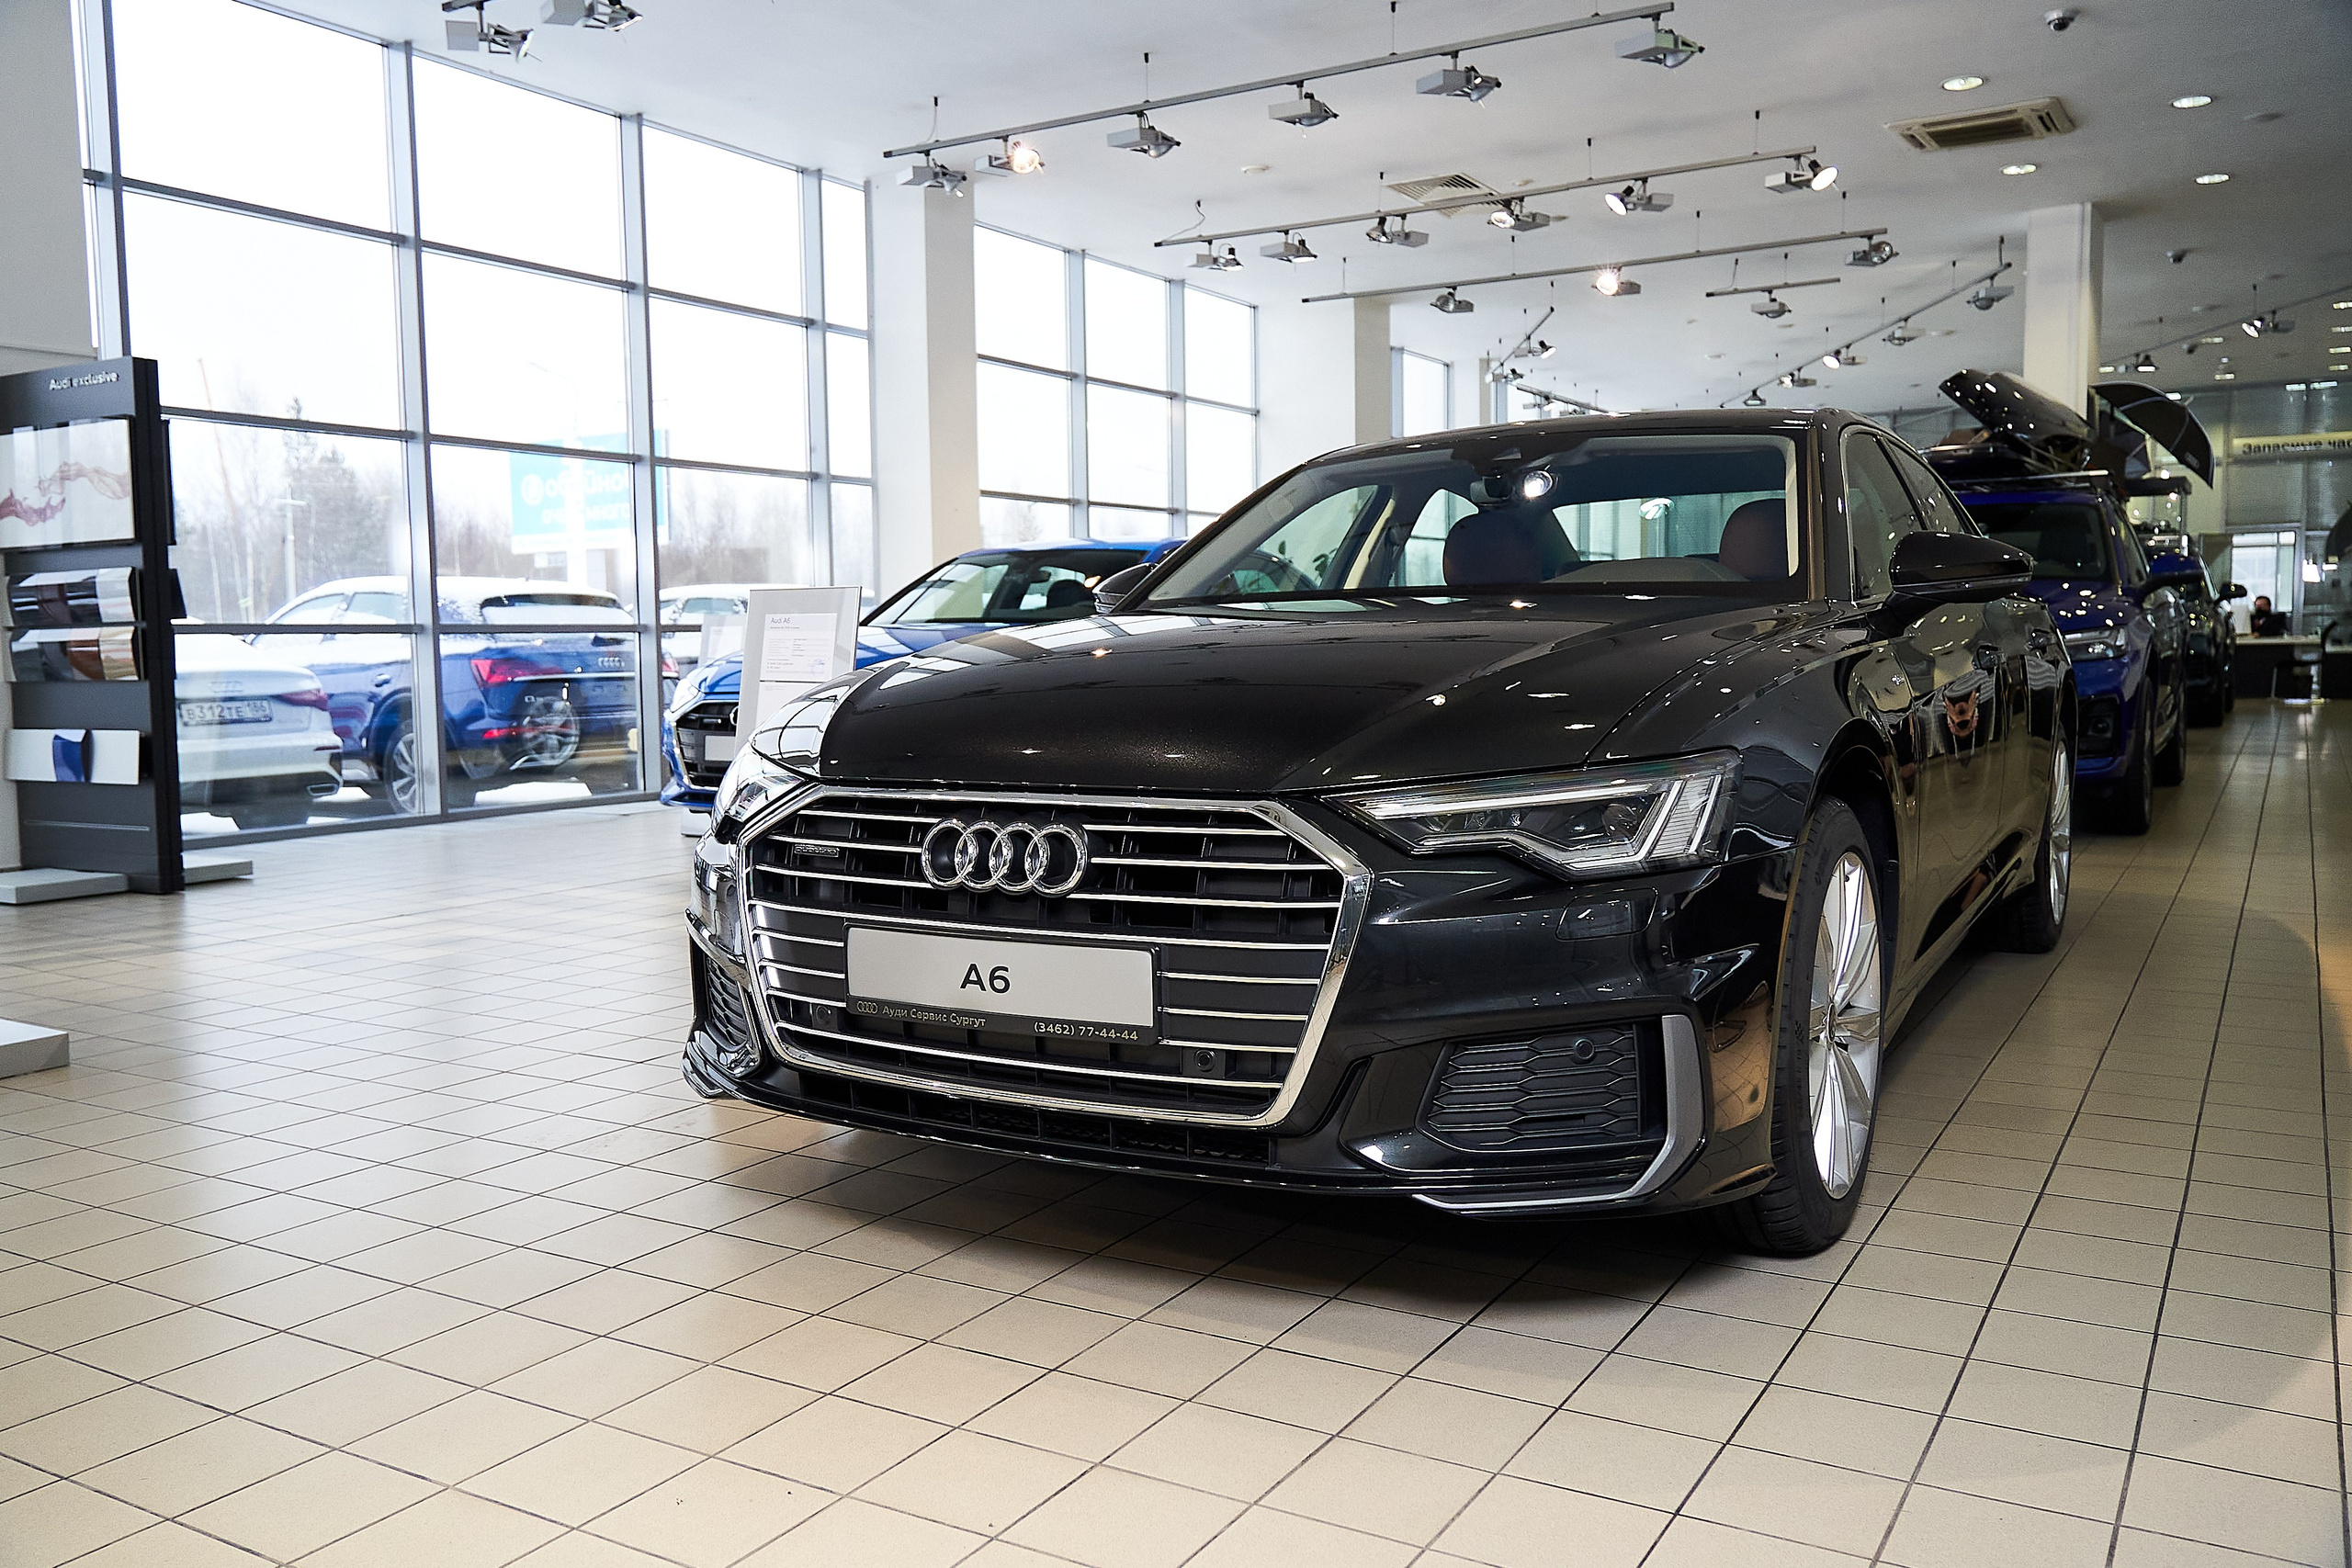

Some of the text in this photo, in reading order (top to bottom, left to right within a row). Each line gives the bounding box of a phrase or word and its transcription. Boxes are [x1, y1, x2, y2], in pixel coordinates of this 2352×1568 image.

[50, 371, 119, 390] Audi exclusive
[960, 963, 1011, 994] A6
[882, 1006, 986, 1028] Ауди Сервис Сургут
[1034, 1021, 1138, 1041] (3462) 77-44-44
